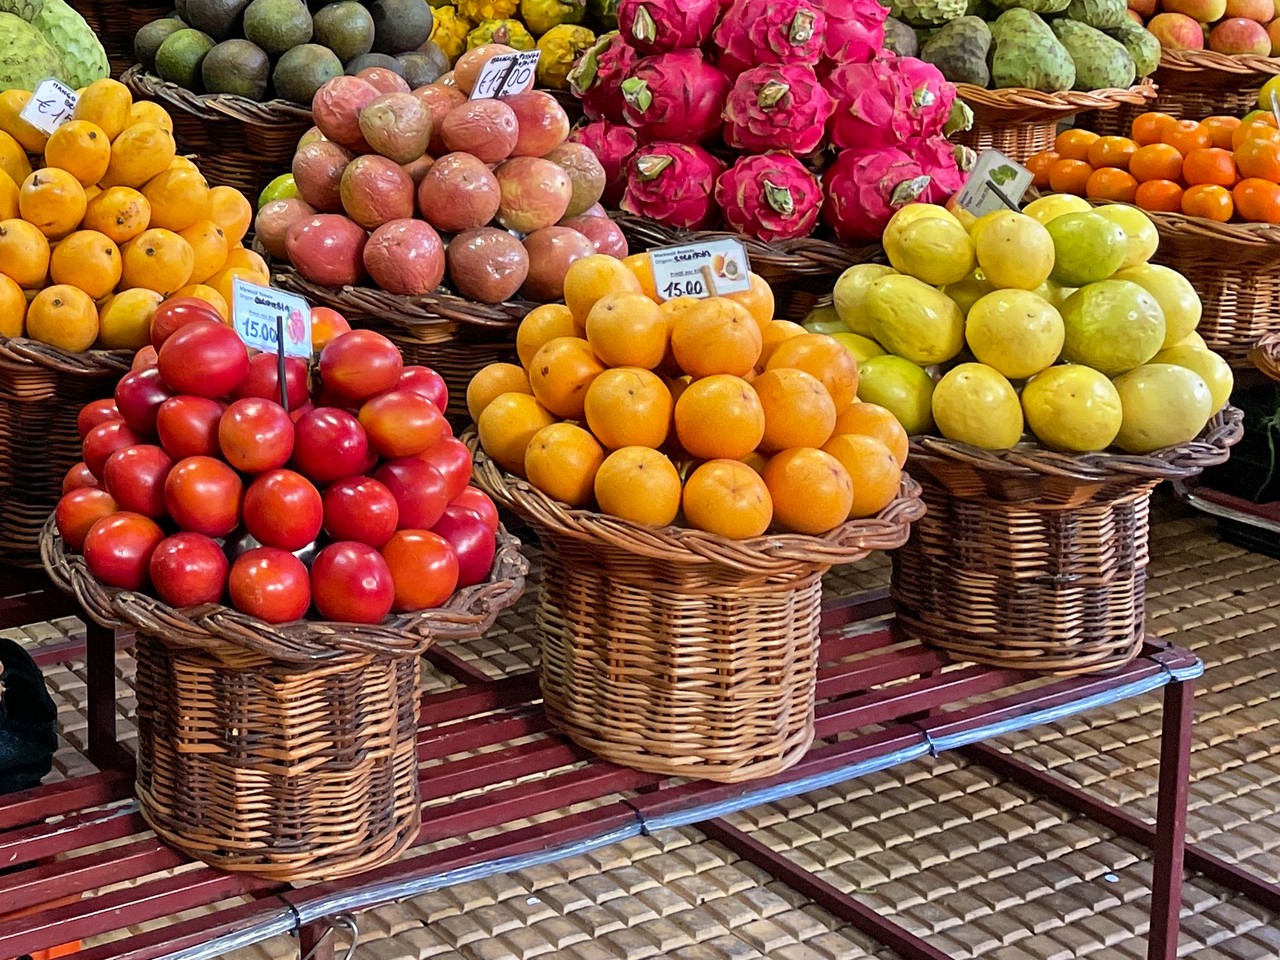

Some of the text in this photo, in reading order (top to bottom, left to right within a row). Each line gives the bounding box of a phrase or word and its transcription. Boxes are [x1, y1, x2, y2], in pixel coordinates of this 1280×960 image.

[52, 82, 77, 102] MANGO
[663, 280, 703, 298] 15.00
[242, 317, 280, 343] 15.00
